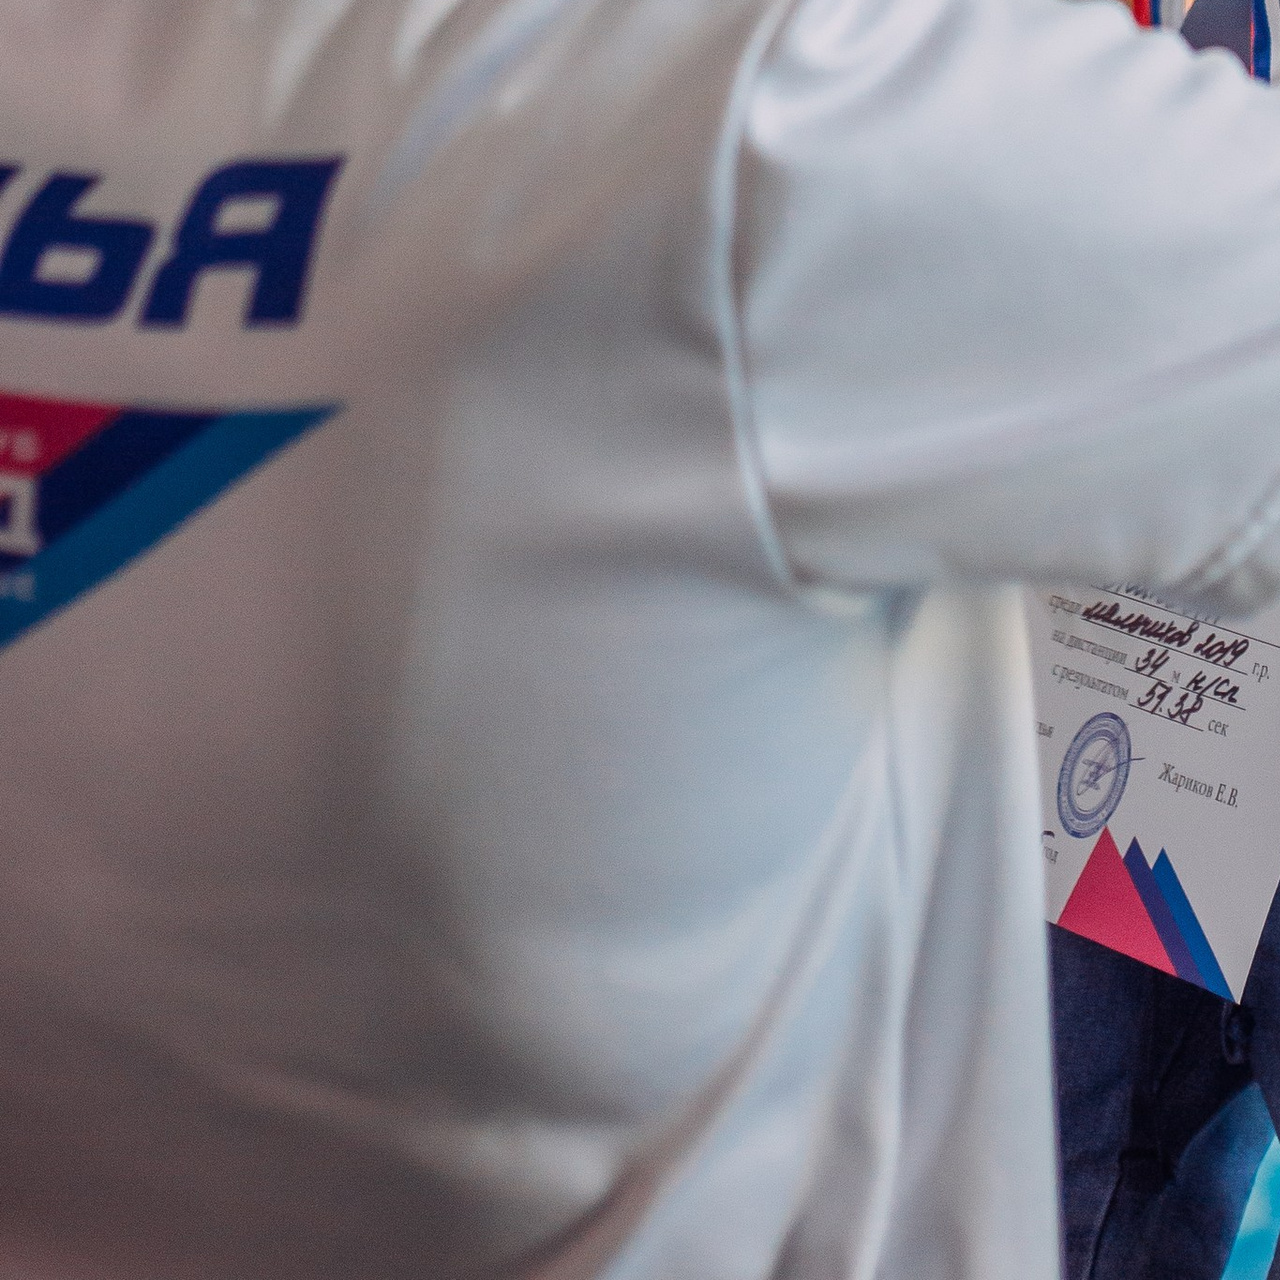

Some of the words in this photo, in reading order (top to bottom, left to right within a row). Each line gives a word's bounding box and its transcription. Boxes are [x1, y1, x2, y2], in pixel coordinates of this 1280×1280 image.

[1193, 632, 1250, 668] 2019
[1207, 716, 1231, 738] сек
[1157, 762, 1213, 799] Жариков
[1213, 782, 1239, 809] Е.В.
